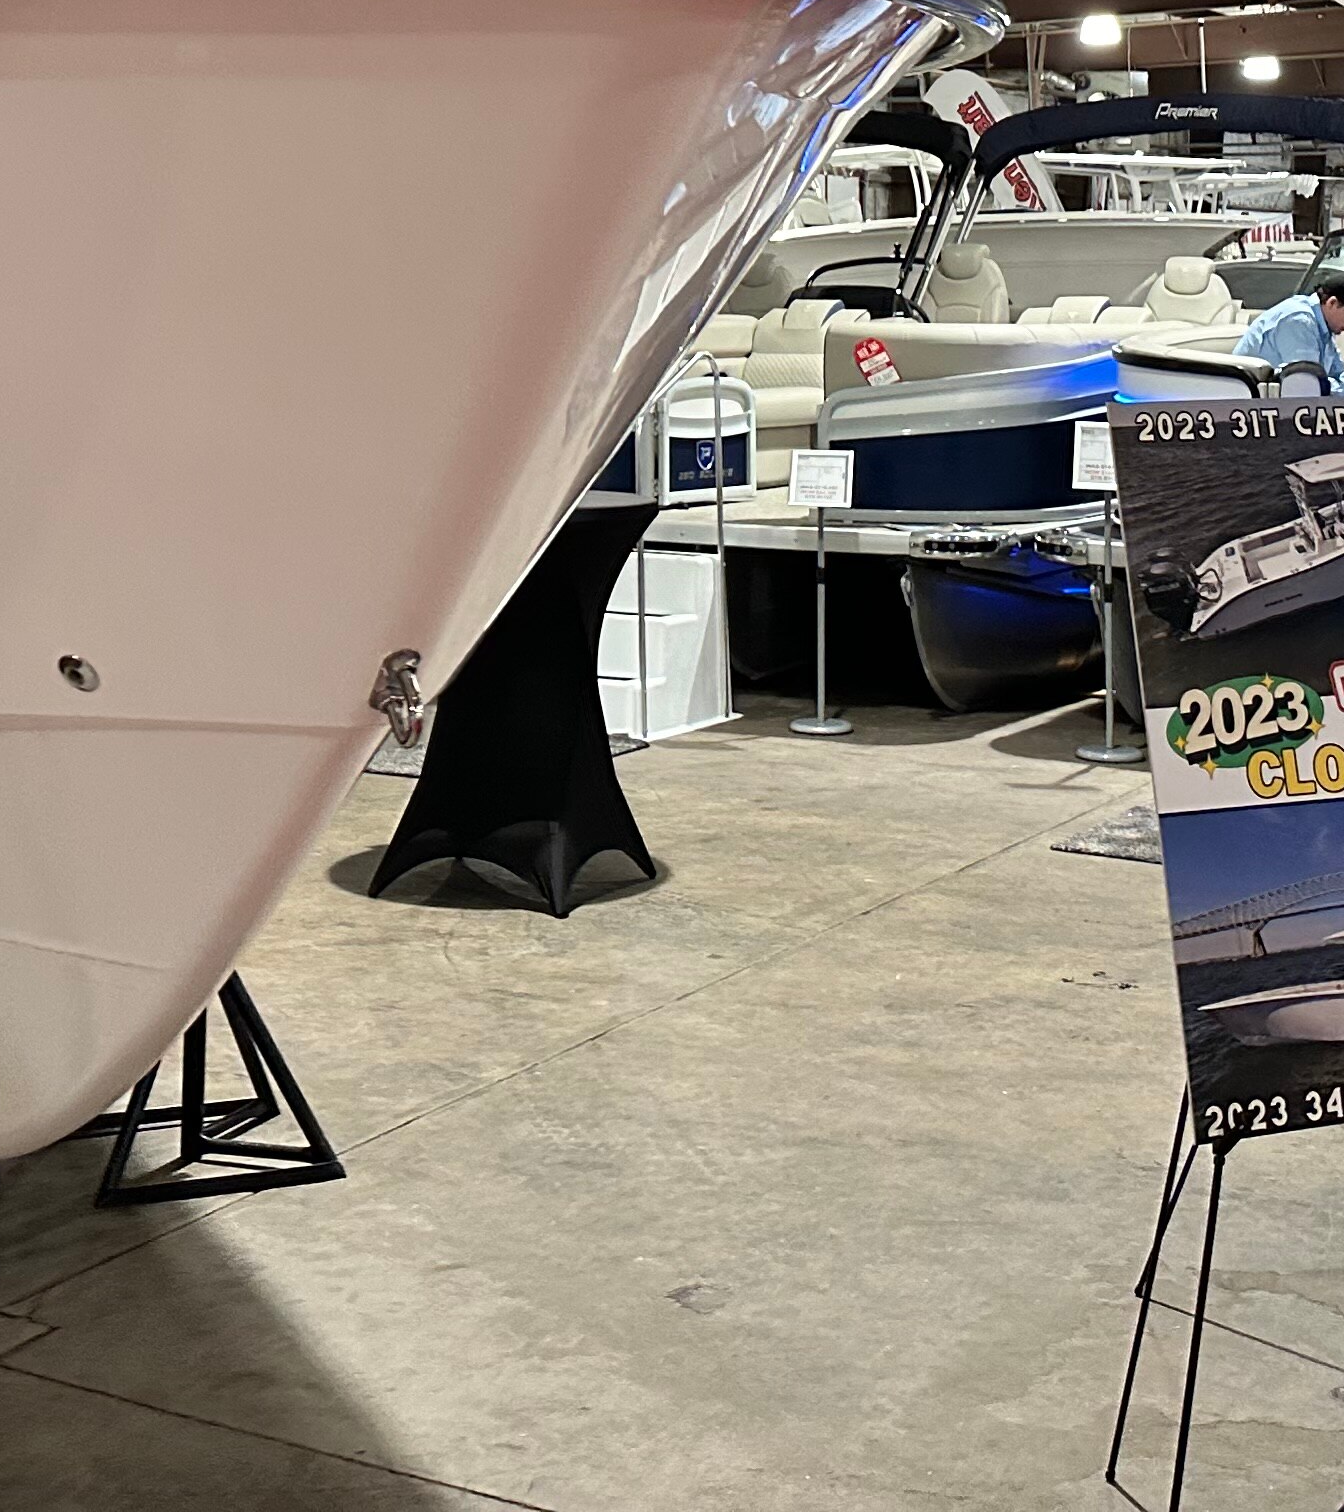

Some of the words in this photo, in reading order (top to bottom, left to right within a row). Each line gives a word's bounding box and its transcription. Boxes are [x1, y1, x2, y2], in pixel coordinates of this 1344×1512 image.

[1135, 410, 1217, 442] 2023
[1229, 407, 1279, 439] 31T
[1178, 683, 1313, 756] 2023
[1204, 1095, 1288, 1138] 2023
